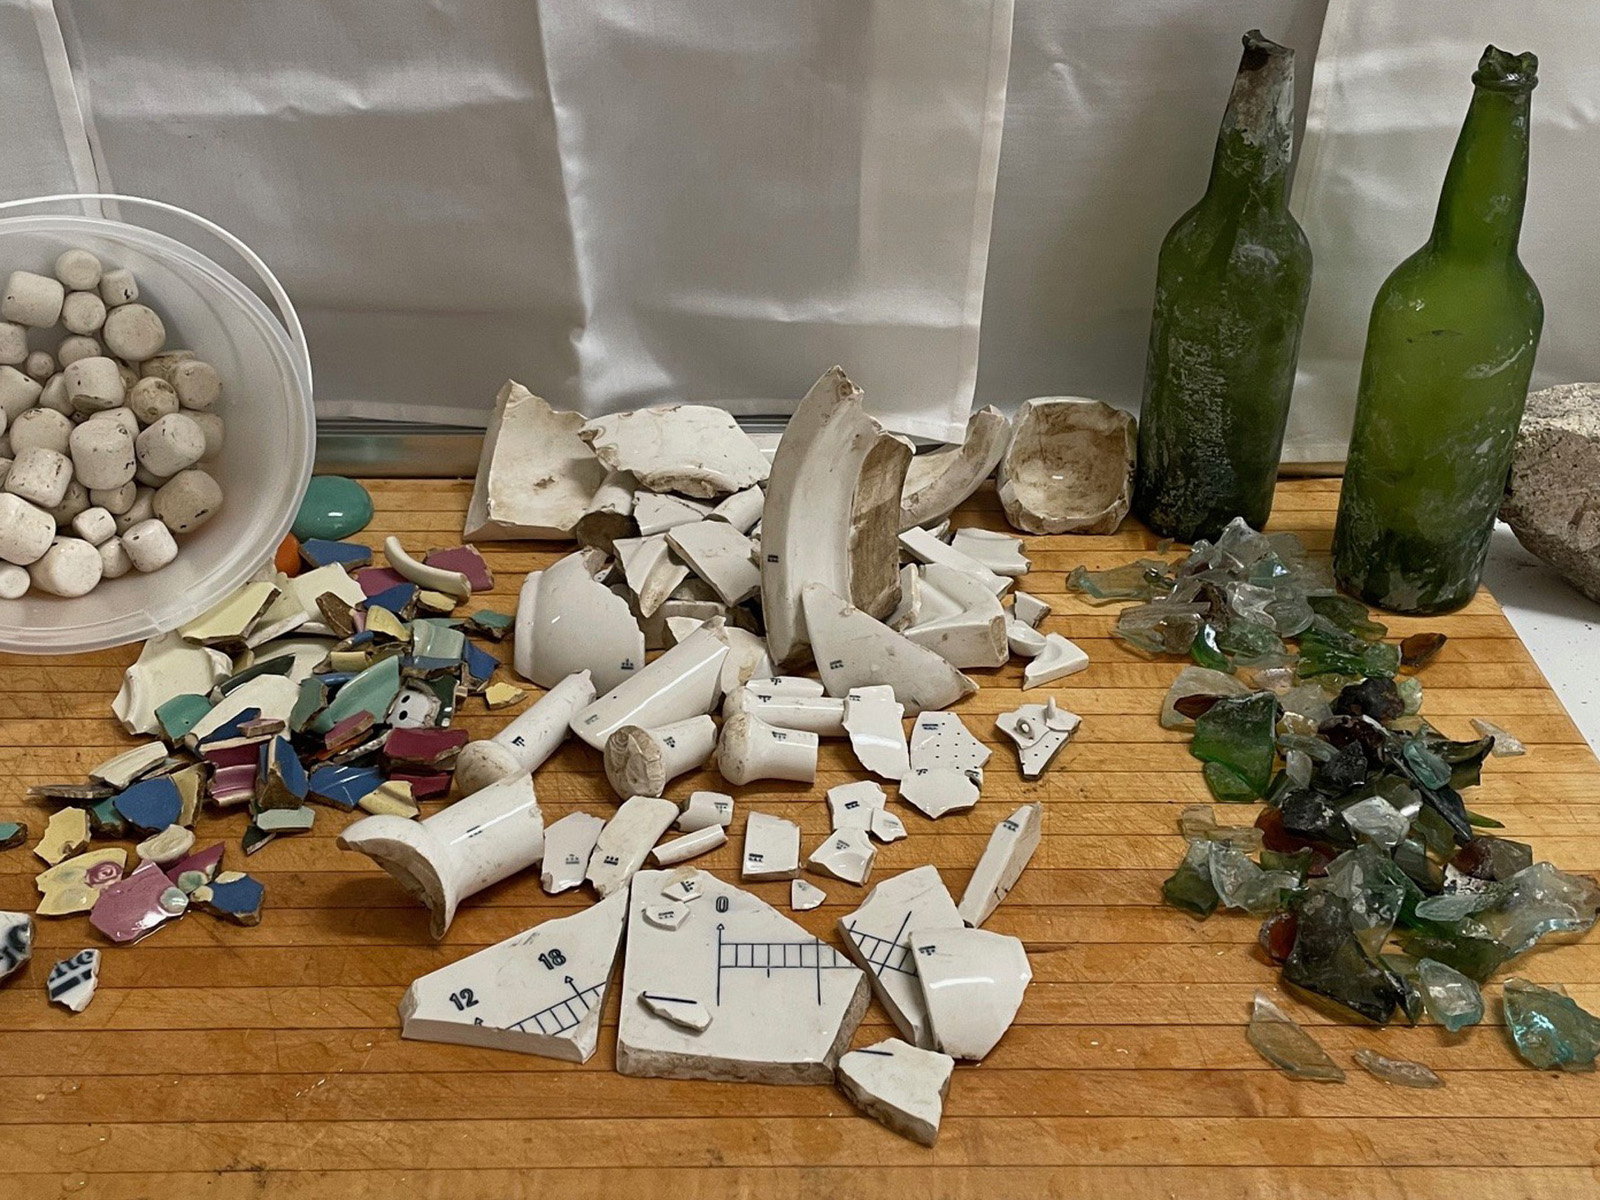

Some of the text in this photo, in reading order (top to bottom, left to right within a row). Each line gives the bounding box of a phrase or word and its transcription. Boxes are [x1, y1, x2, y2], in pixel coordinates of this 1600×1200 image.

[715, 895, 729, 913] 0
[538, 948, 567, 971] 18
[449, 988, 479, 1012] 12
